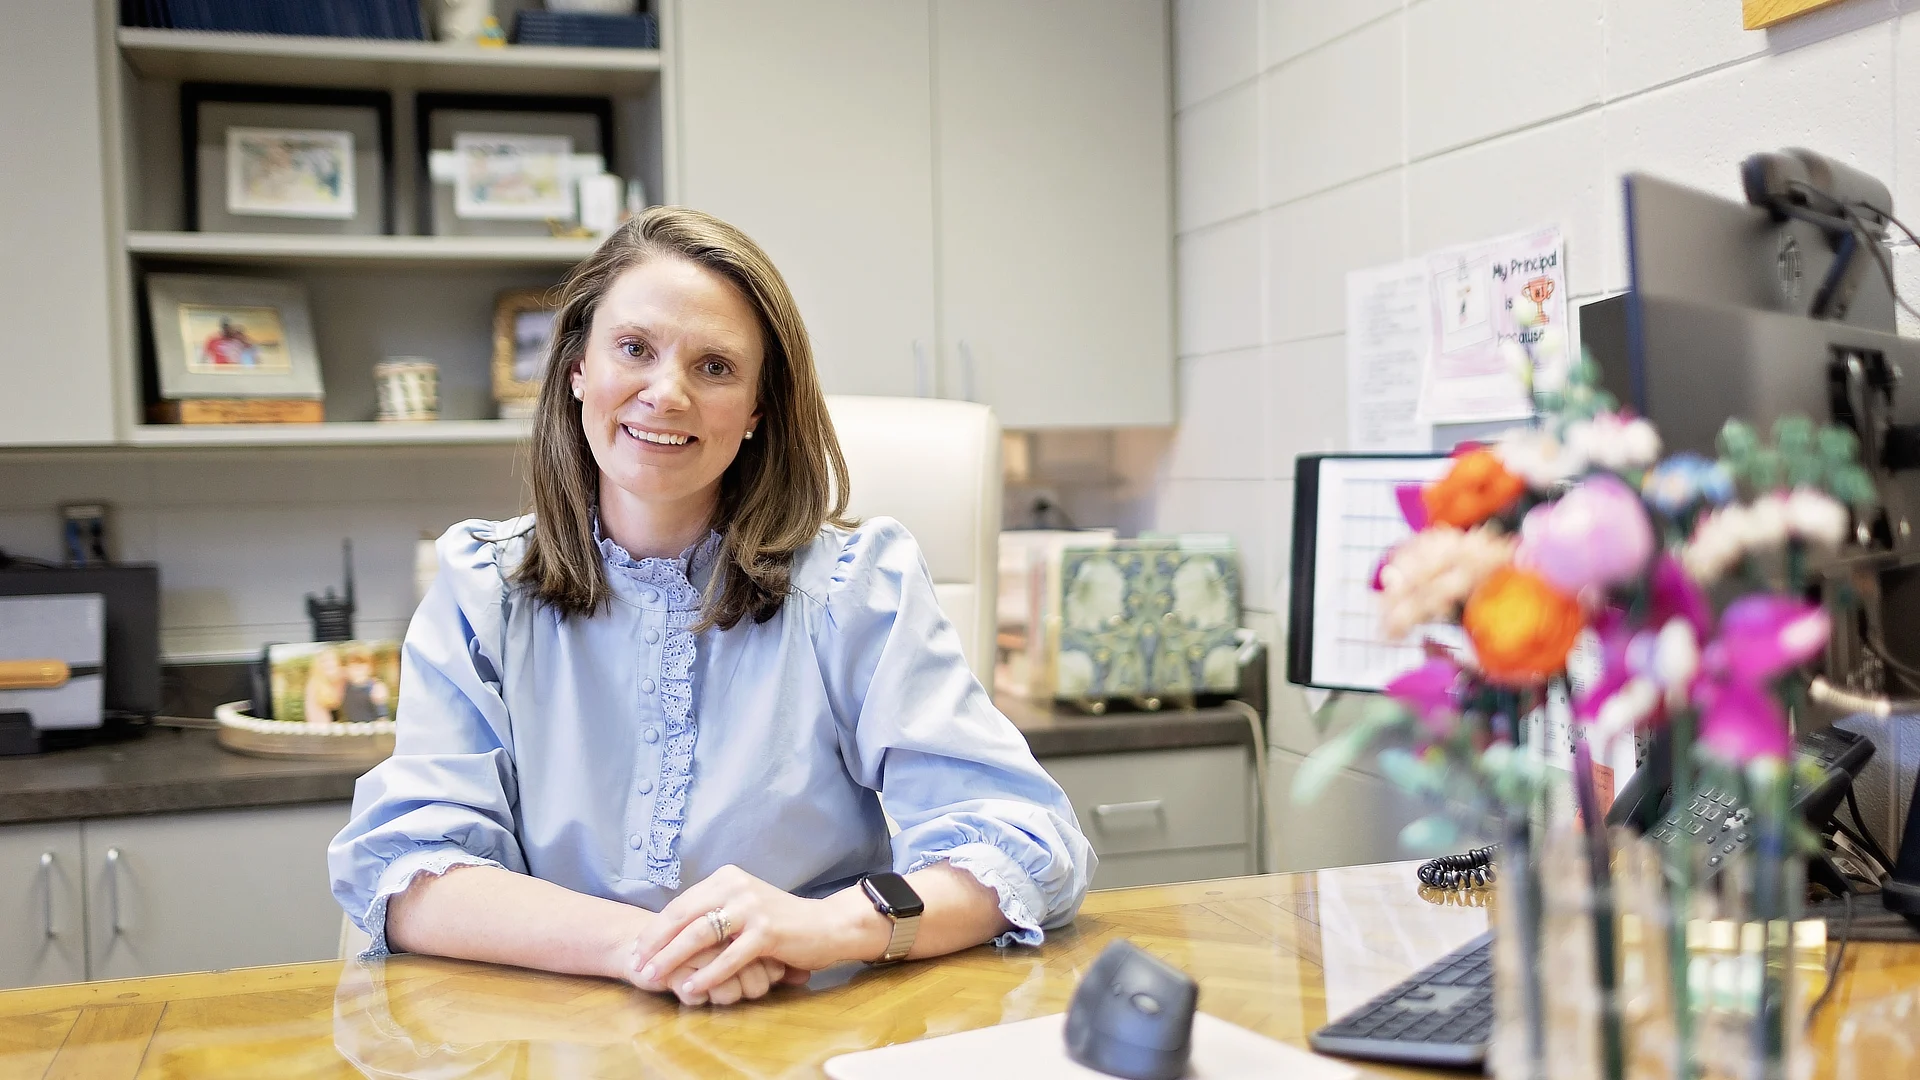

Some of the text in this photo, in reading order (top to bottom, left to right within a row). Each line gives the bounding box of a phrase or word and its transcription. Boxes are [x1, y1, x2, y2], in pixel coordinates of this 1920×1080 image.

[1493, 251, 1557, 281] My Principal
[1505, 287, 1544, 310] is #1
[1498, 330, 1544, 345] ause
